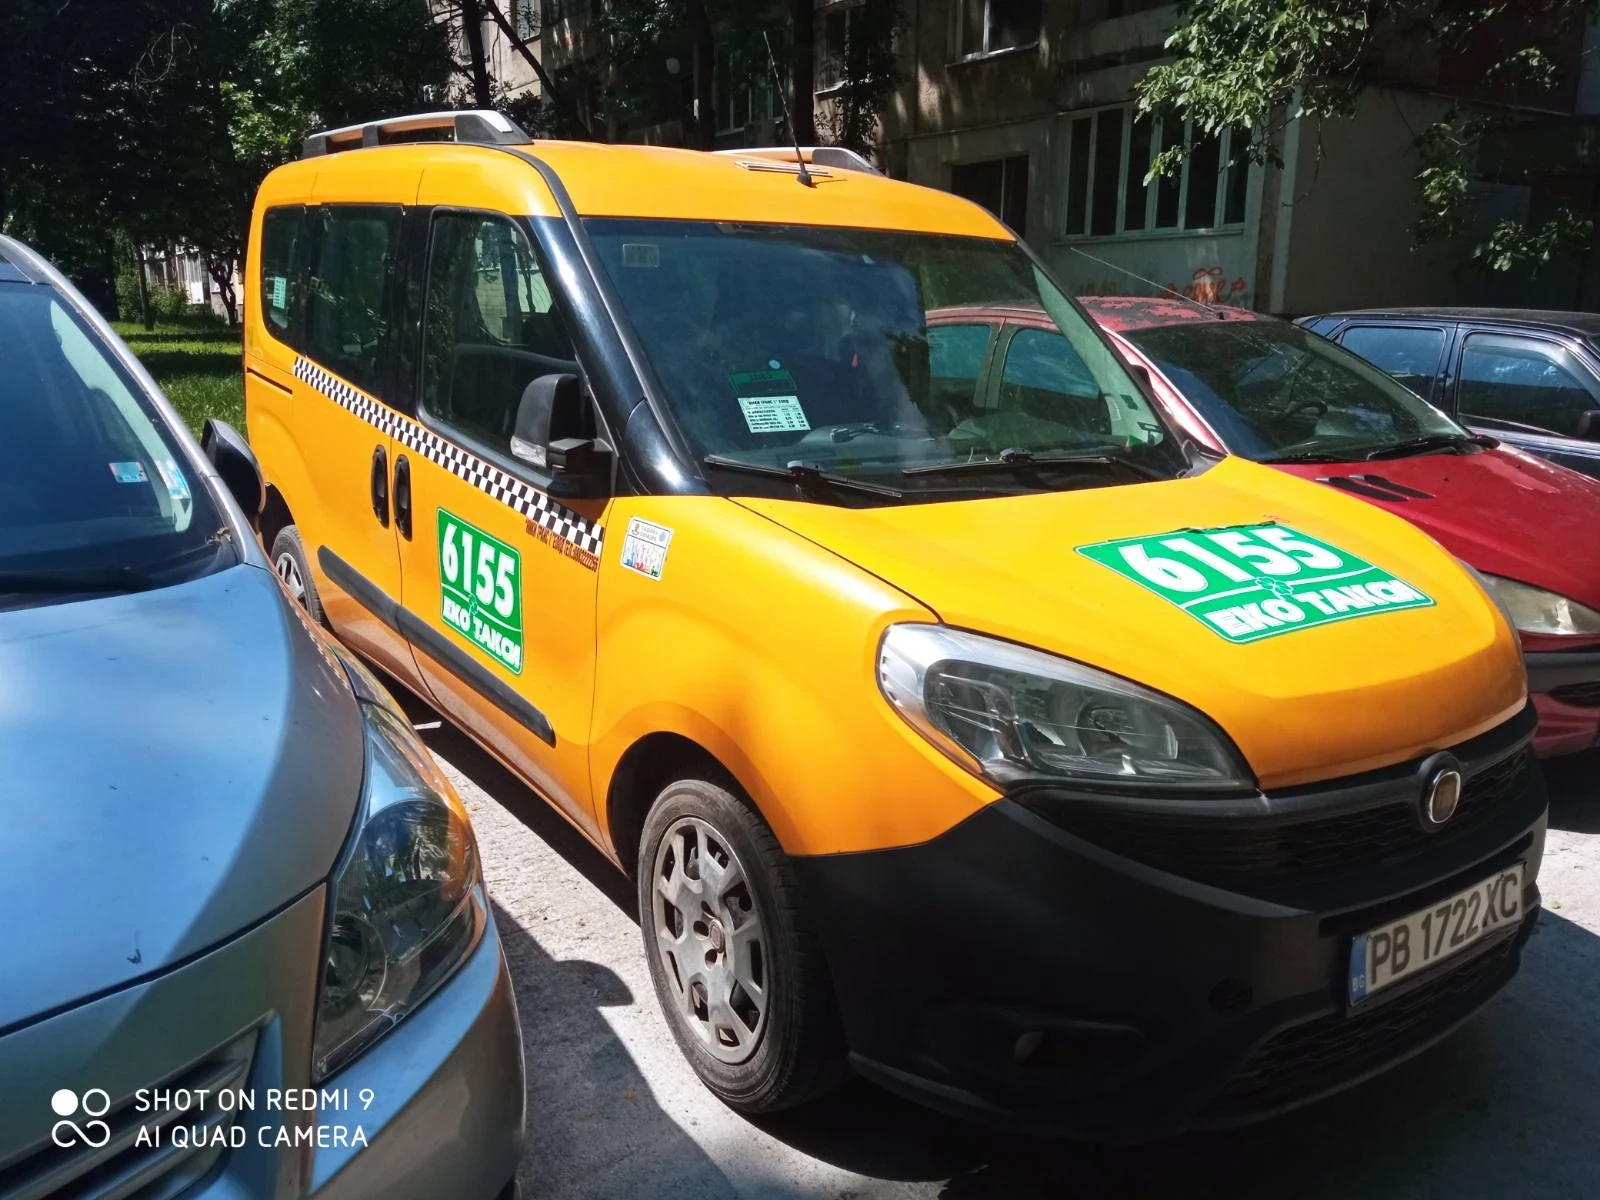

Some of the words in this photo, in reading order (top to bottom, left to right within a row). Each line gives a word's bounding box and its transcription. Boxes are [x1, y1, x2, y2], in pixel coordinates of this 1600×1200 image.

[442, 522, 515, 618] 6155
[1117, 527, 1344, 592] 6155
[443, 595, 471, 632] ЕКО
[474, 615, 521, 669] ТАКСИ
[1202, 599, 1306, 638] ЕКО
[1294, 579, 1423, 615] ТАКСИ
[1352, 975, 1365, 991] BG
